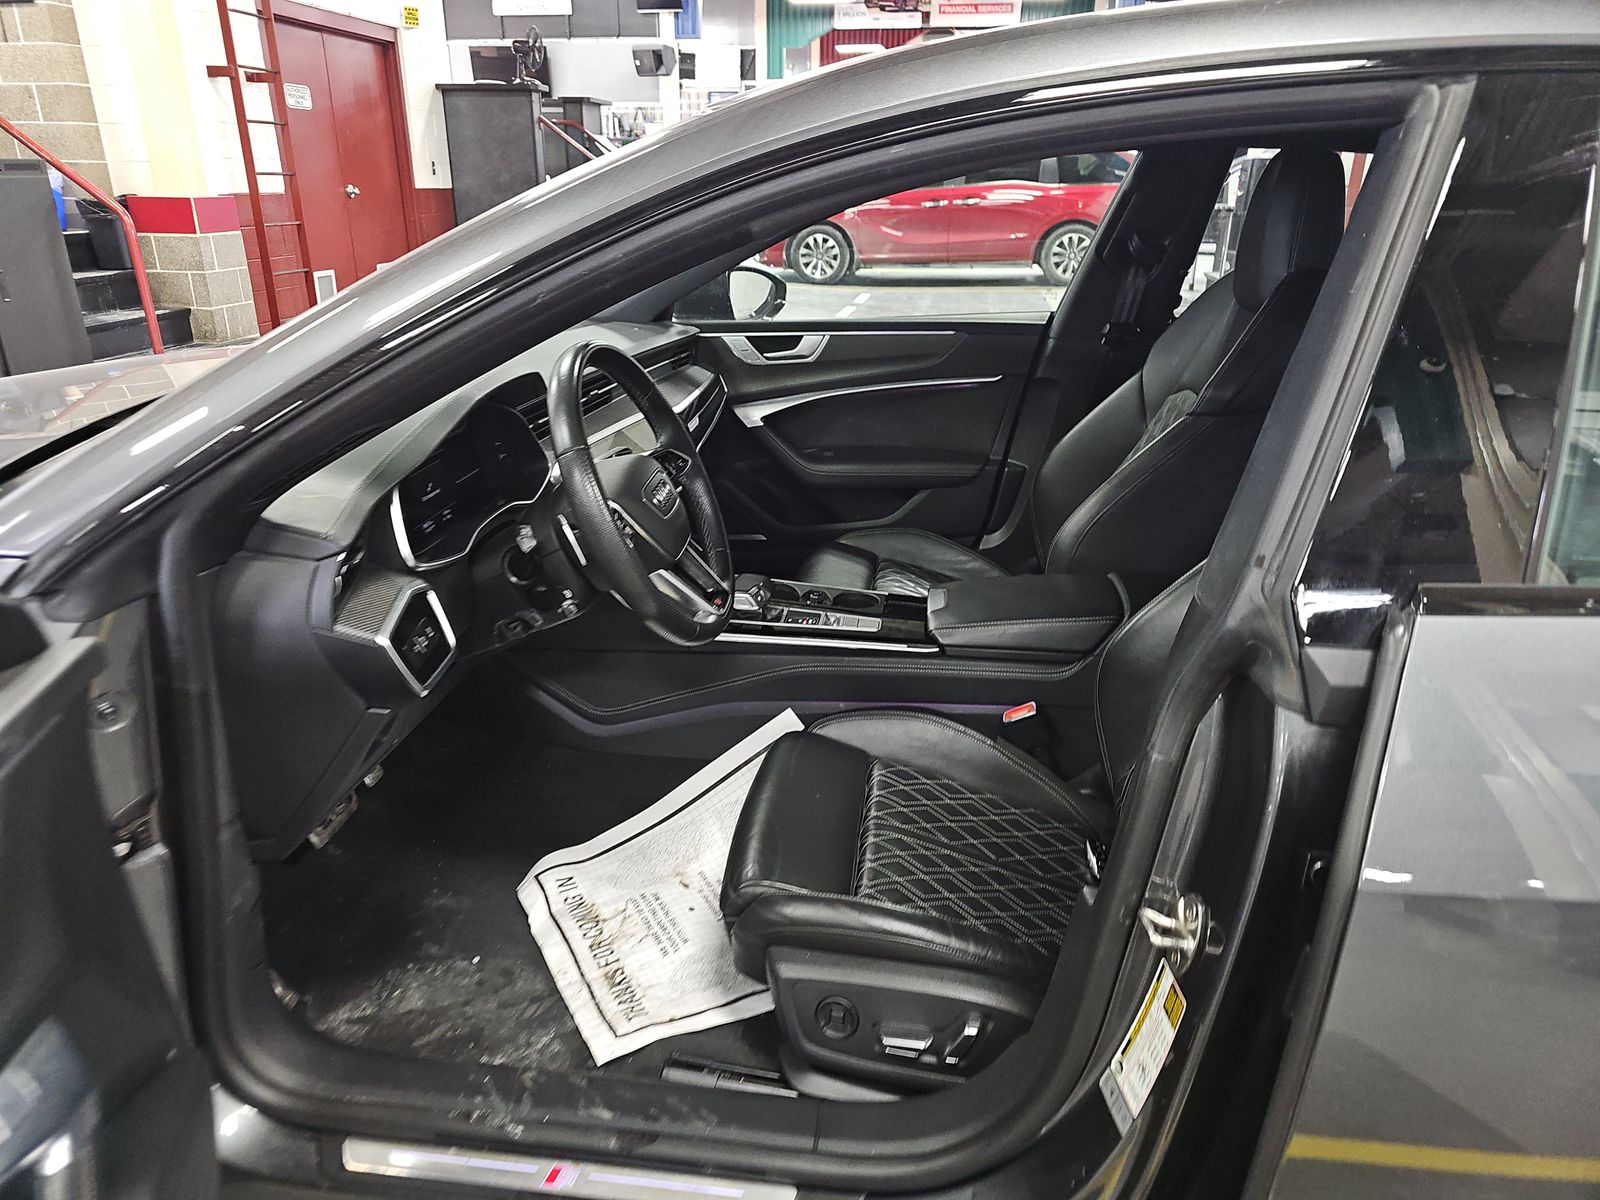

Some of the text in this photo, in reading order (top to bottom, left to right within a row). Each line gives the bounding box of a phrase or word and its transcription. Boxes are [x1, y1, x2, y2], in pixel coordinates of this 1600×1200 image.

[941, 4, 1011, 13] FINANCIAL SERVICES
[555, 875, 649, 1022] THANKS FOR COMING IN
